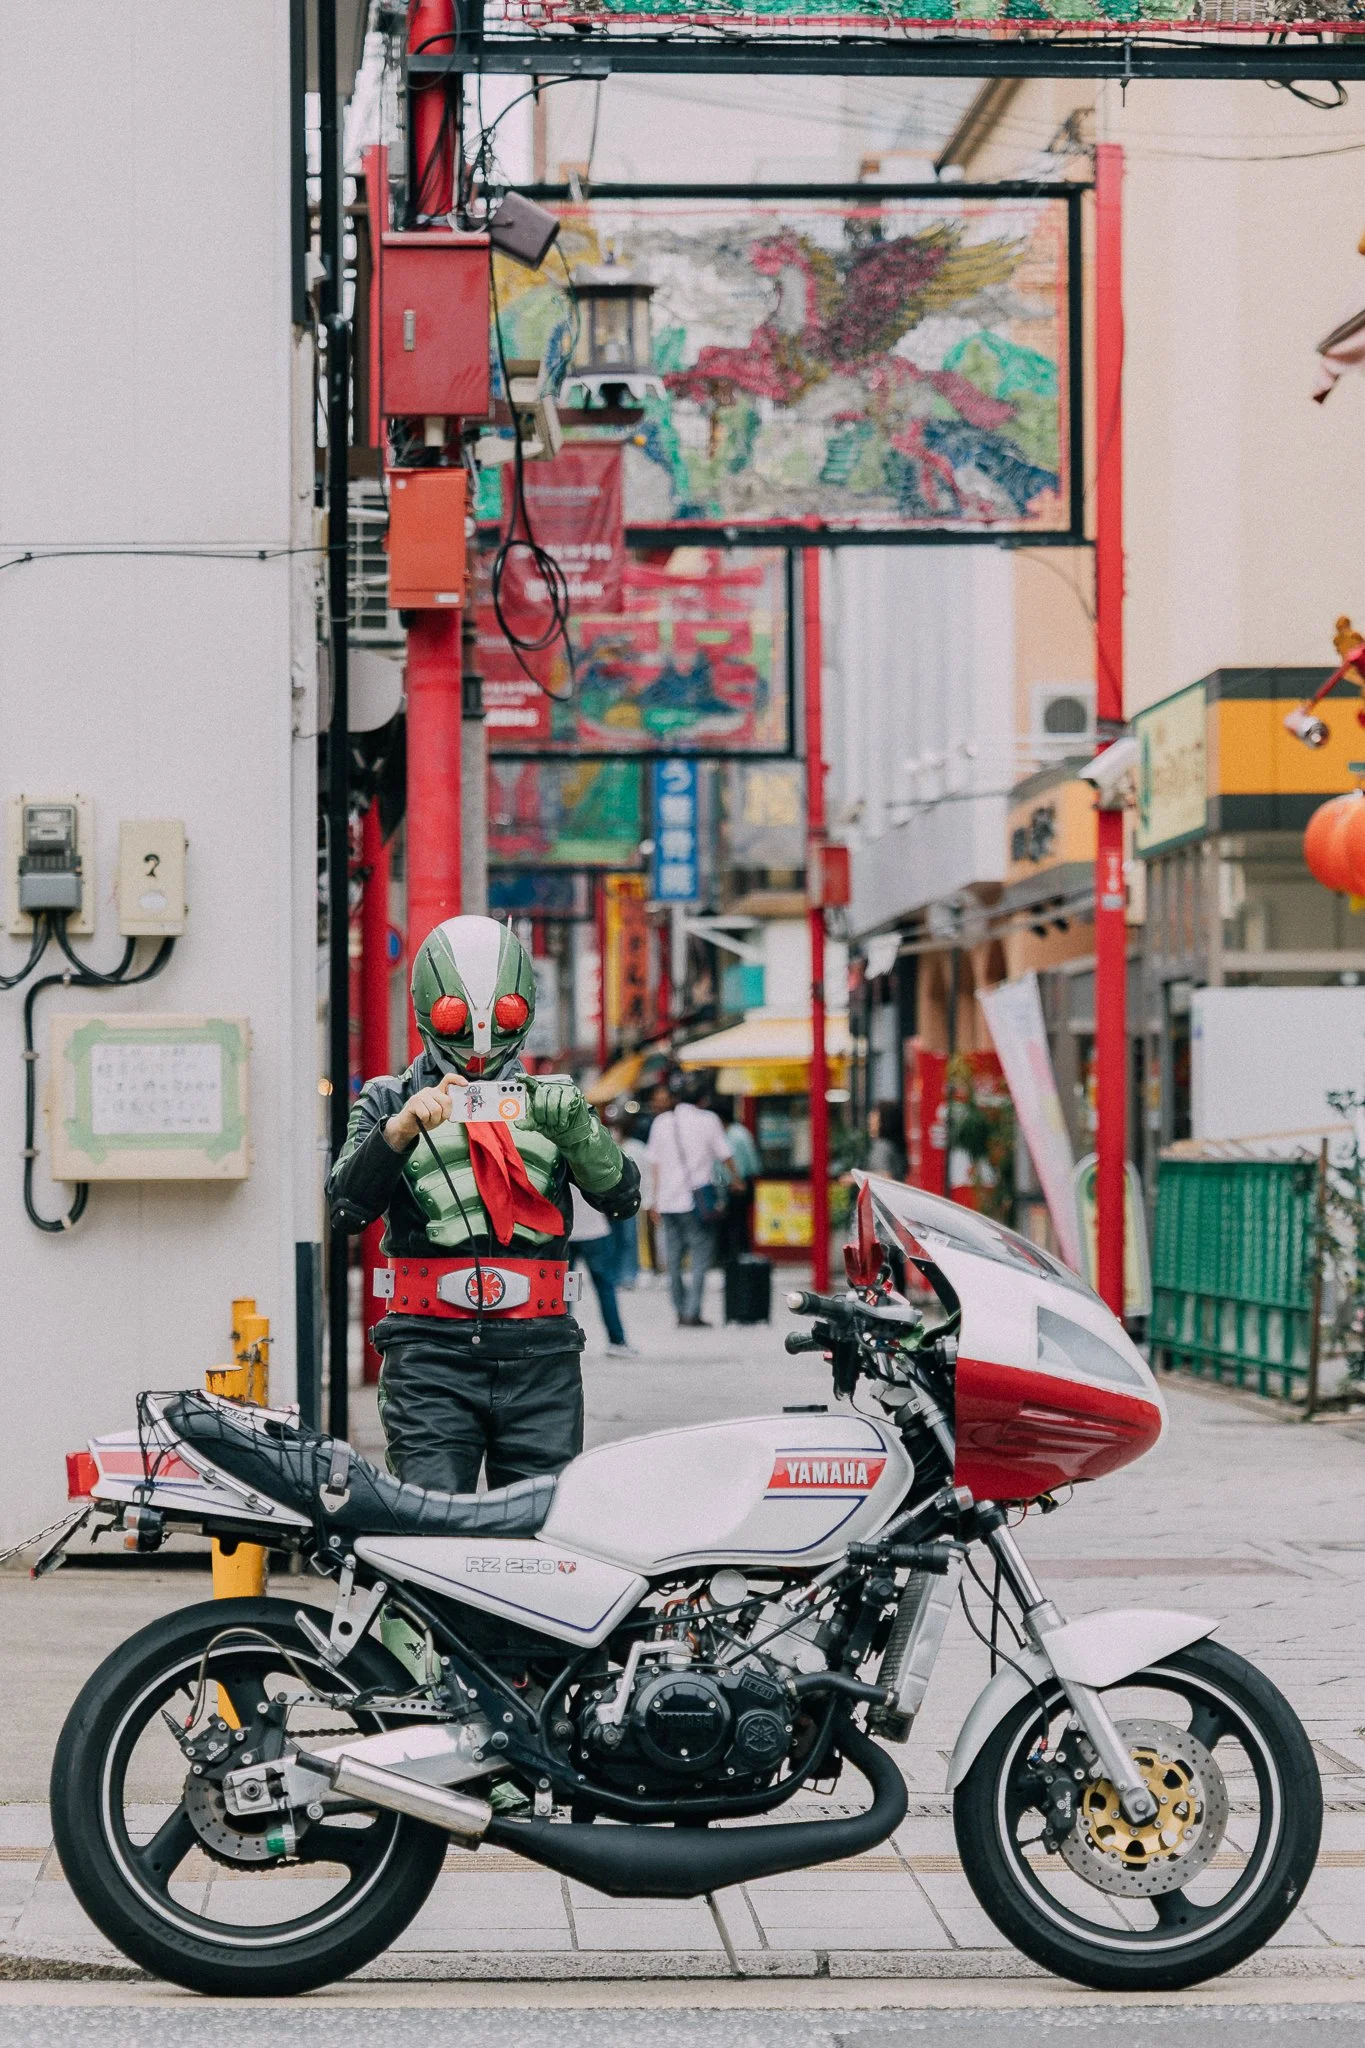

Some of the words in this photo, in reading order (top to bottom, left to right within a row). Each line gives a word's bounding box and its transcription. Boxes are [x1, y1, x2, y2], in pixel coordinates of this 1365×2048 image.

[786, 1461, 869, 1485] YAMAHA
[466, 1556, 501, 1573] RZ
[505, 1557, 556, 1575] 250
